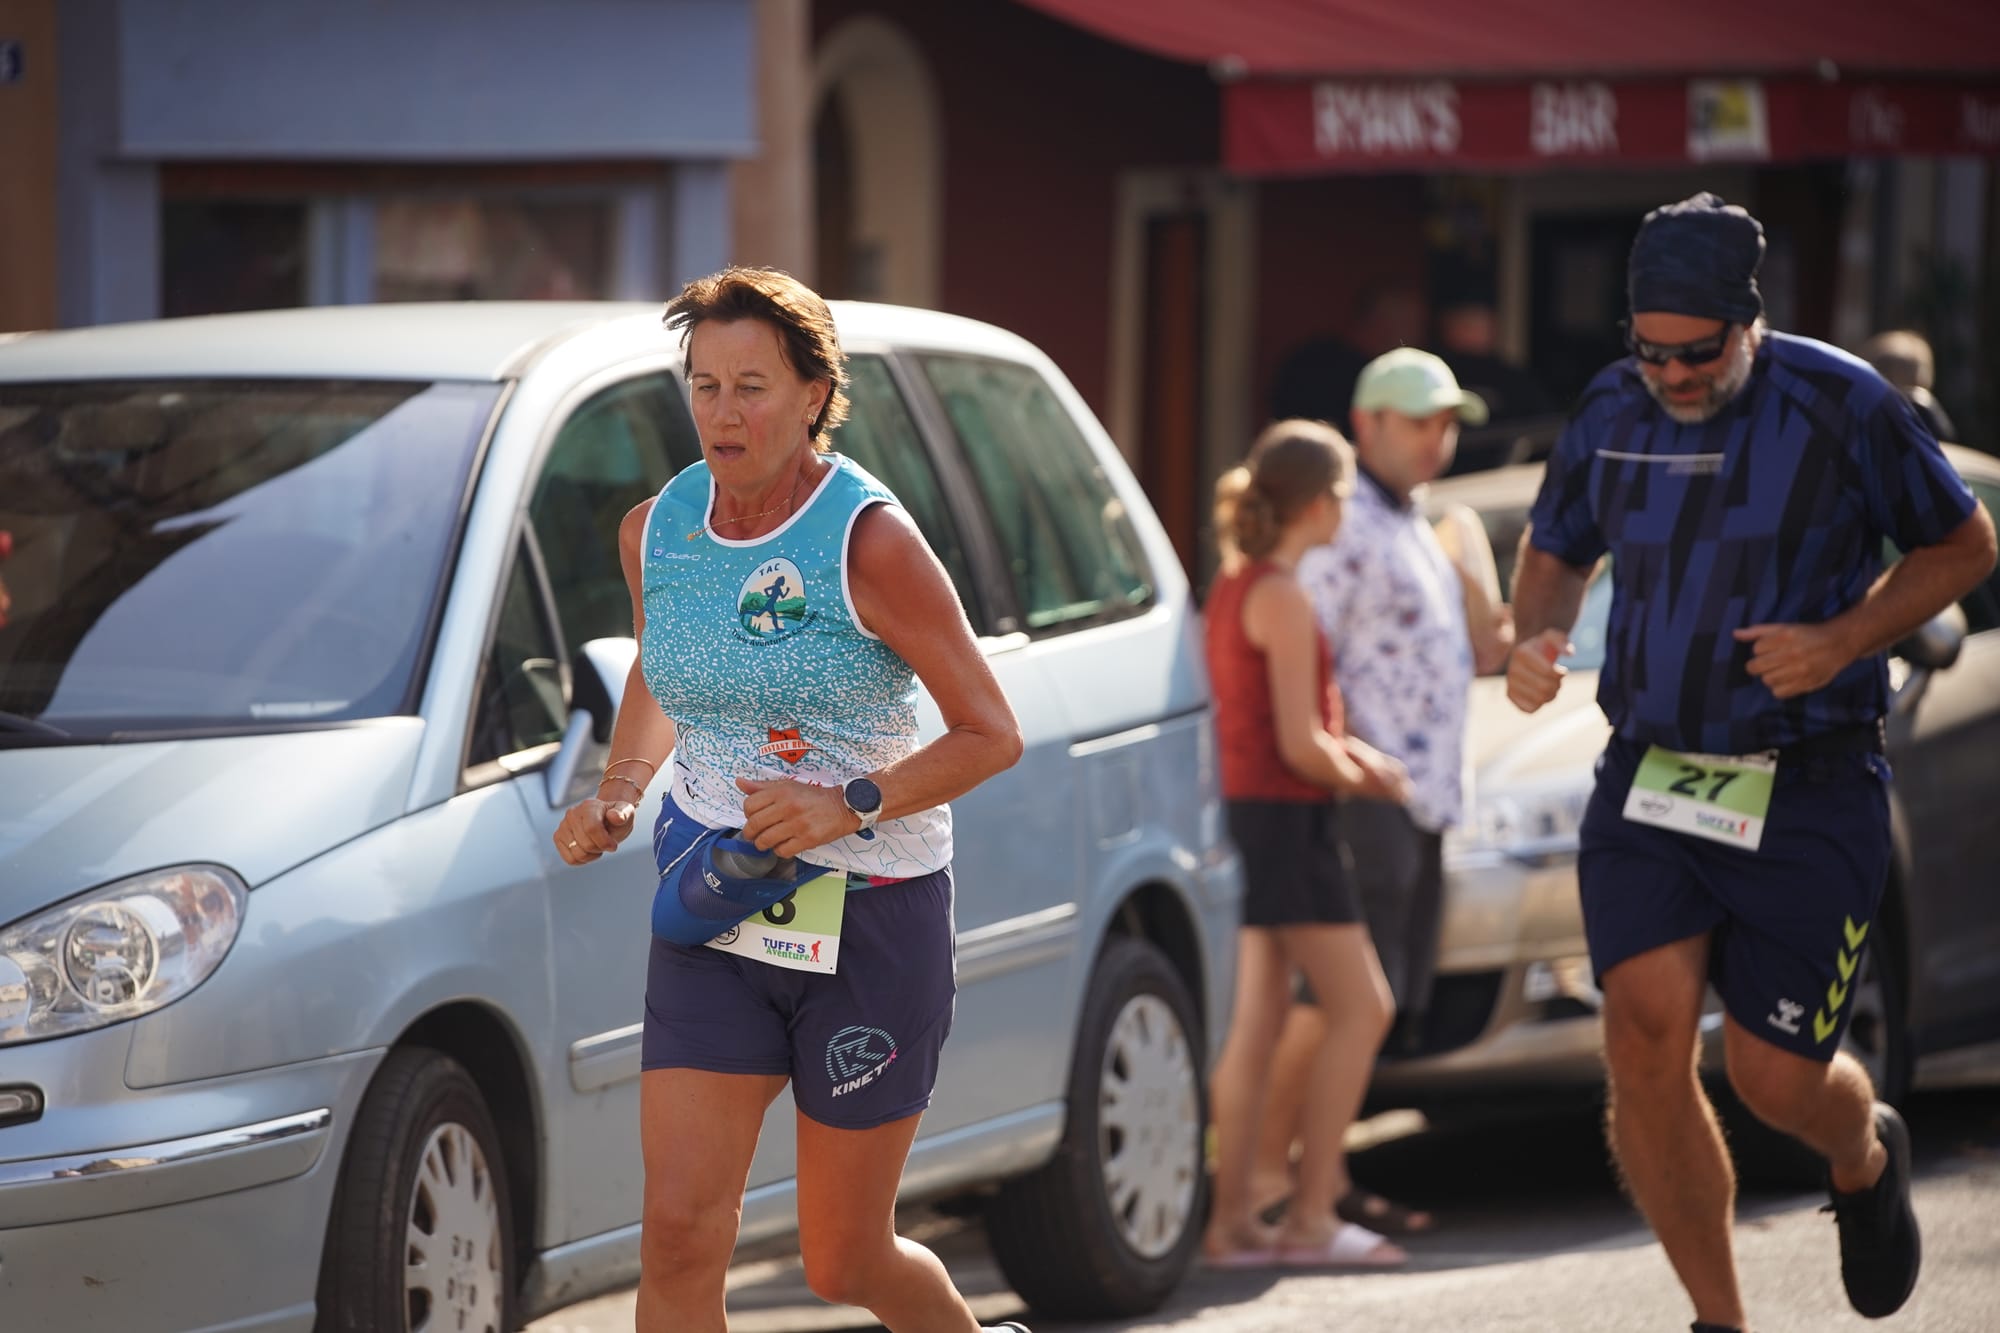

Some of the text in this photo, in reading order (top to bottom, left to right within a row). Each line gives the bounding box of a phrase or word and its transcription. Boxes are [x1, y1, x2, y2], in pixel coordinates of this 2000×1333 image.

[1529, 81, 1619, 154] BAR
[759, 563, 780, 576] TAC
[761, 742, 789, 754] INSTANT
[1669, 765, 1739, 803] 27
[762, 936, 806, 954] TUFF'S
[766, 946, 810, 962] Aventure
